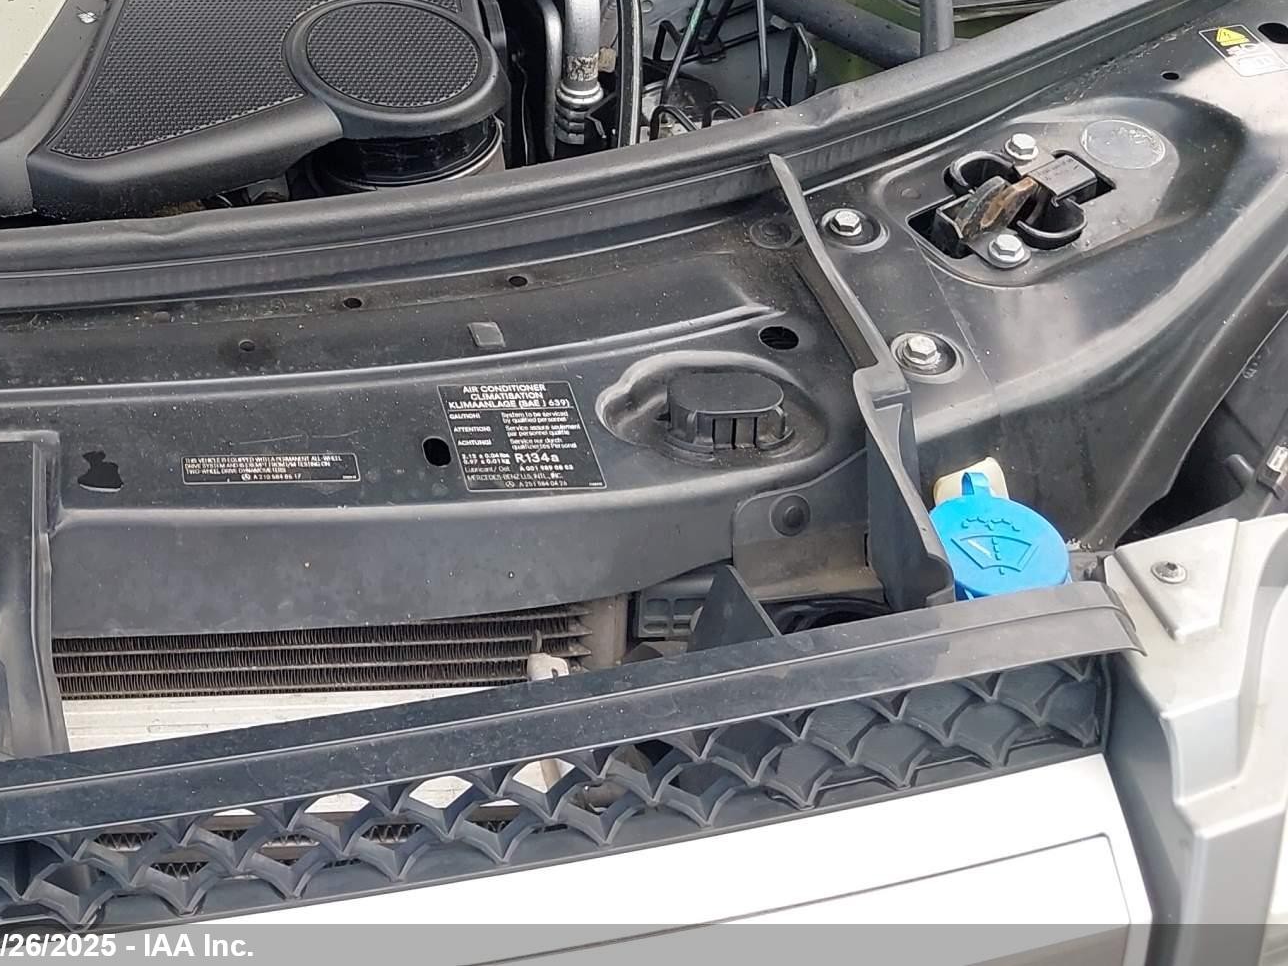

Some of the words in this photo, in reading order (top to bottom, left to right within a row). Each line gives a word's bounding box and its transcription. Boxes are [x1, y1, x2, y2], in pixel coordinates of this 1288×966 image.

[463, 386, 479, 394] AIR
[480, 384, 546, 392] CONDITIONER
[470, 392, 544, 400] CLIMATISATION
[449, 400, 517, 409] KLIMAANLAGE
[514, 452, 560, 464] R134a
